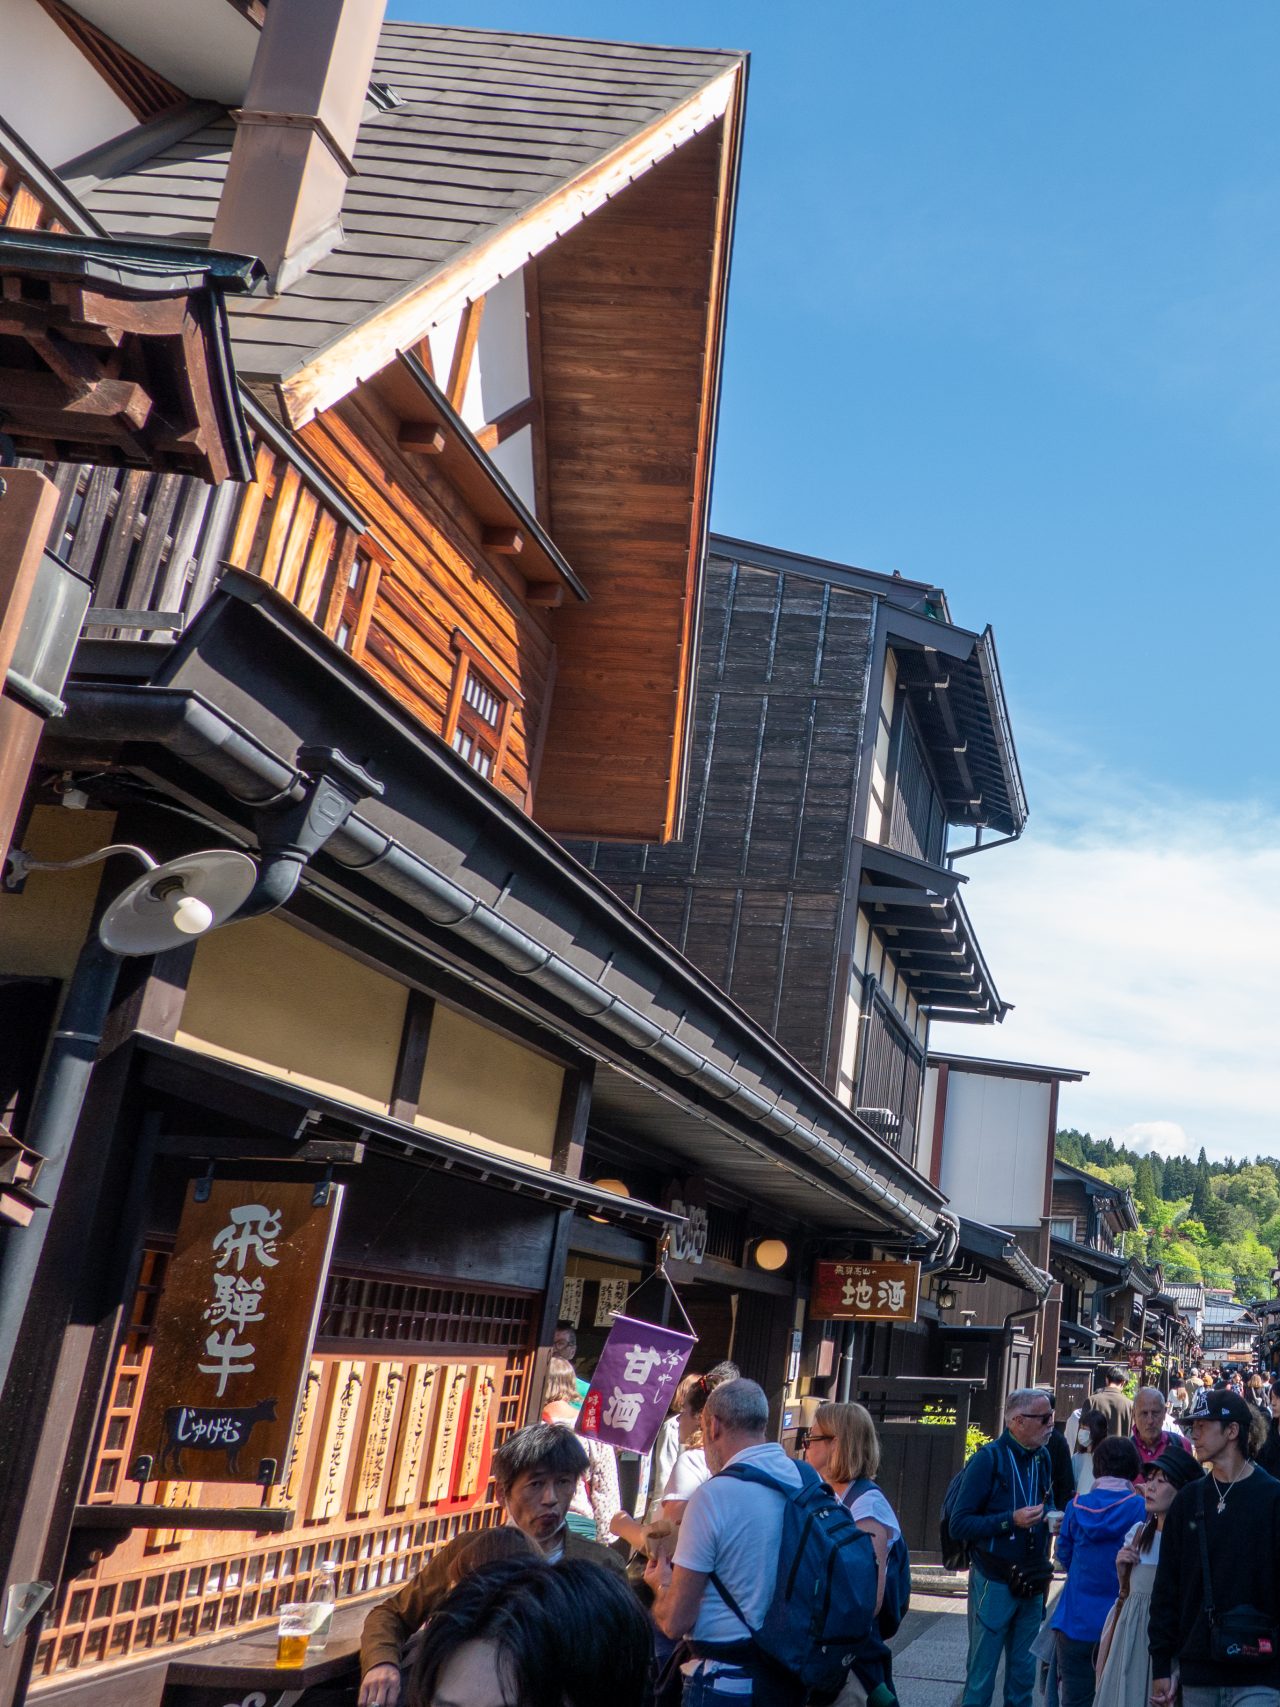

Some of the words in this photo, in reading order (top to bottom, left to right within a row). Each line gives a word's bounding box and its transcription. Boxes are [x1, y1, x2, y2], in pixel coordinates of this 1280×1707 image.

[841, 1278, 906, 1312] 地酒
[602, 1343, 662, 1432] 甘酒
[652, 1348, 684, 1405] 冷やし
[177, 1407, 243, 1444] じゅげむ
